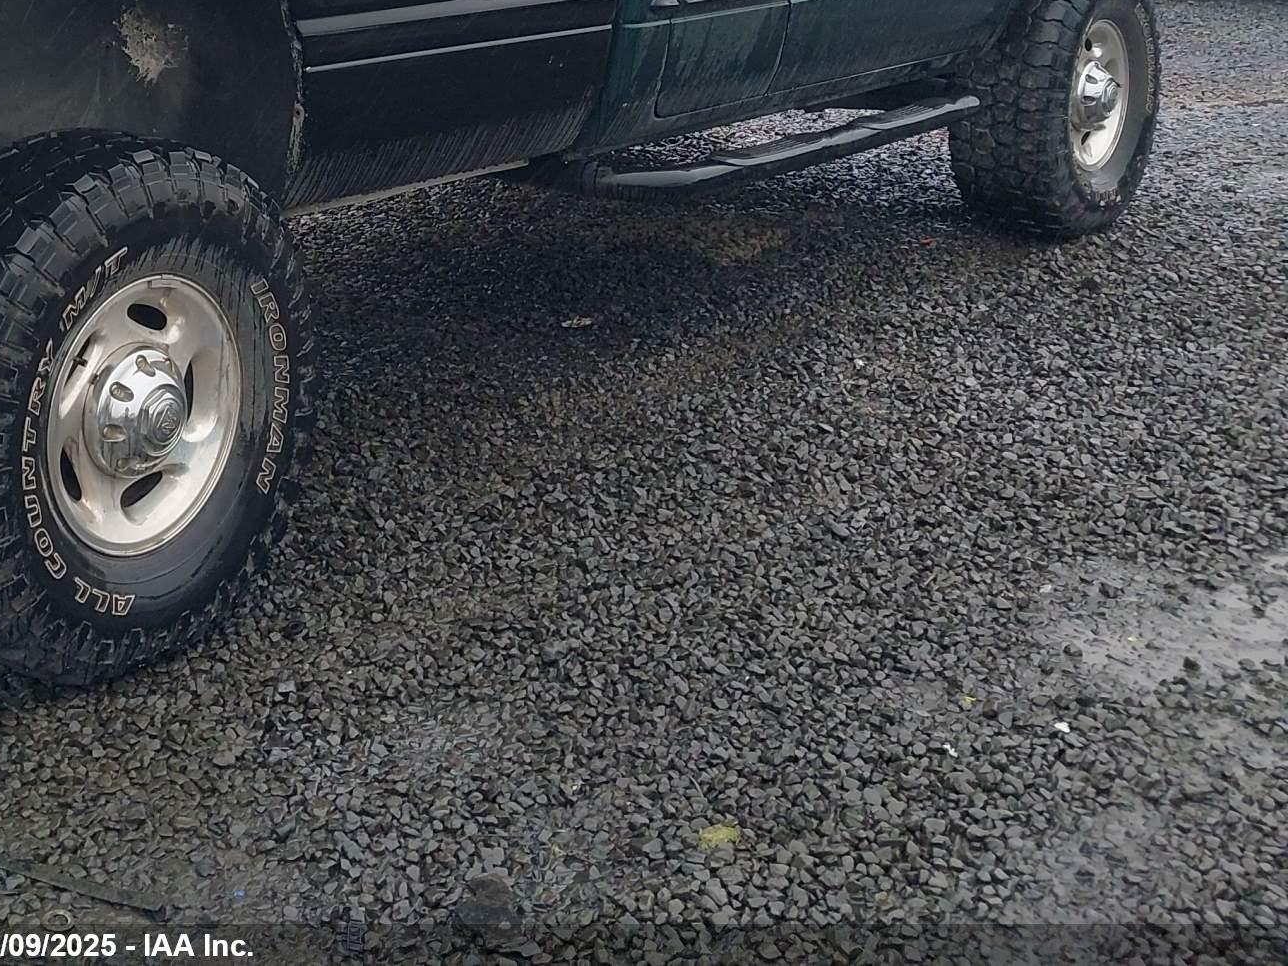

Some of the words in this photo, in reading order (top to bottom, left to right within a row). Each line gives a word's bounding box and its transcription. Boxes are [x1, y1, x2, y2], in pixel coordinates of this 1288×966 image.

[60, 246, 128, 332] M/T
[21, 337, 68, 580] COUNTRY
[250, 277, 292, 495] IRONMAN
[72, 576, 136, 616] ALL
